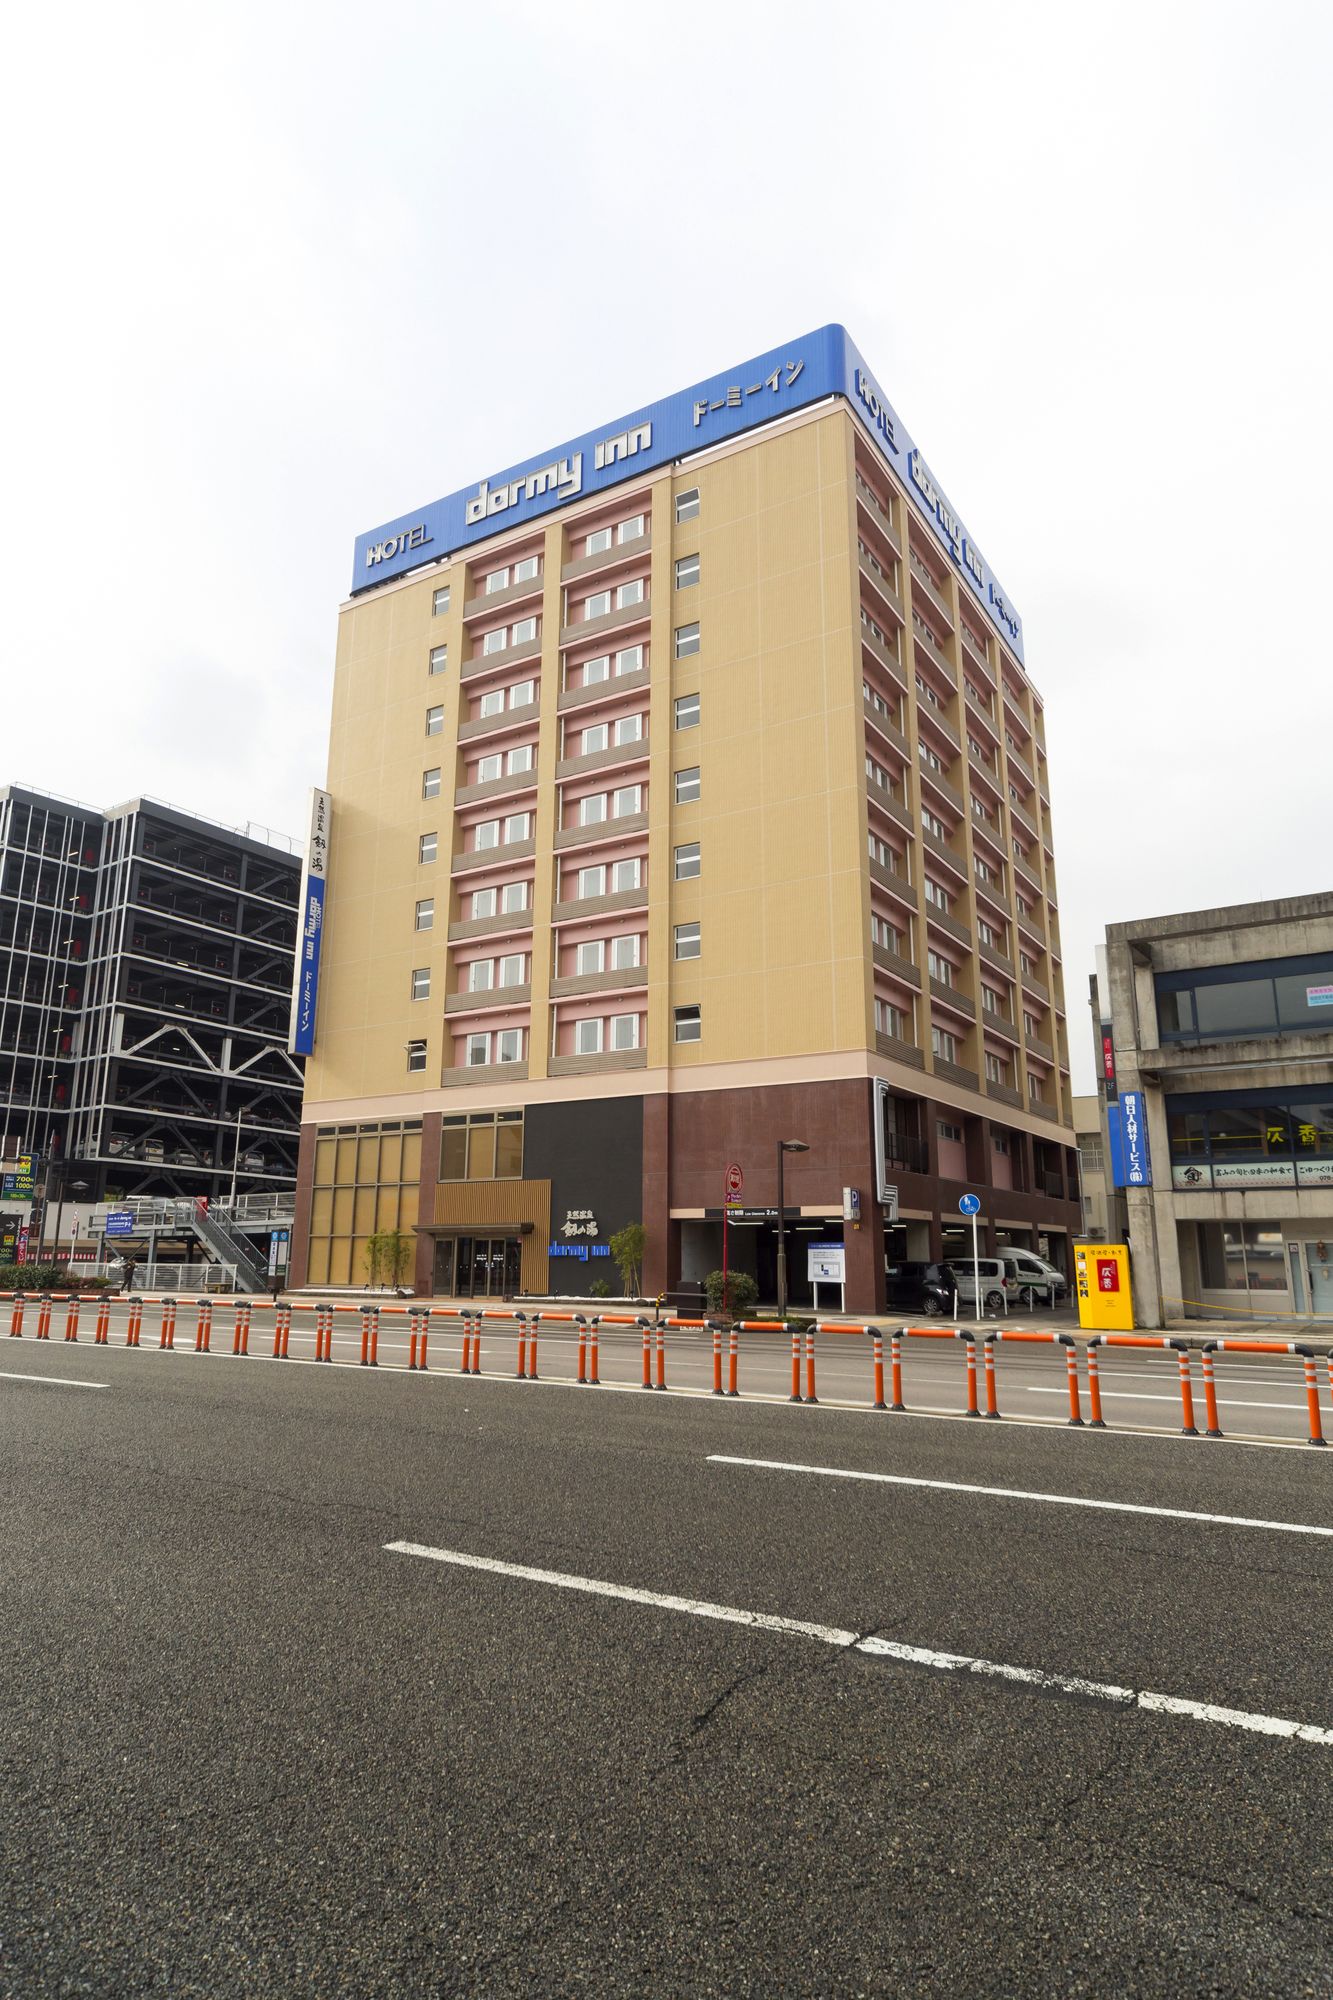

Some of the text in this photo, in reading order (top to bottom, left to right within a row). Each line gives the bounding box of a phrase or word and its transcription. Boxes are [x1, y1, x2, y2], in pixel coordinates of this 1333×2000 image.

[693, 359, 805, 427] ドーミーイン
[465, 420, 652, 525] dormy inn
[366, 524, 434, 567] HOTEL
[304, 896, 322, 960] dormy inn
[301, 970, 312, 1032] ドーミーイン
[851, 1190, 858, 1207] P
[547, 1240, 610, 1261] dormy inn
